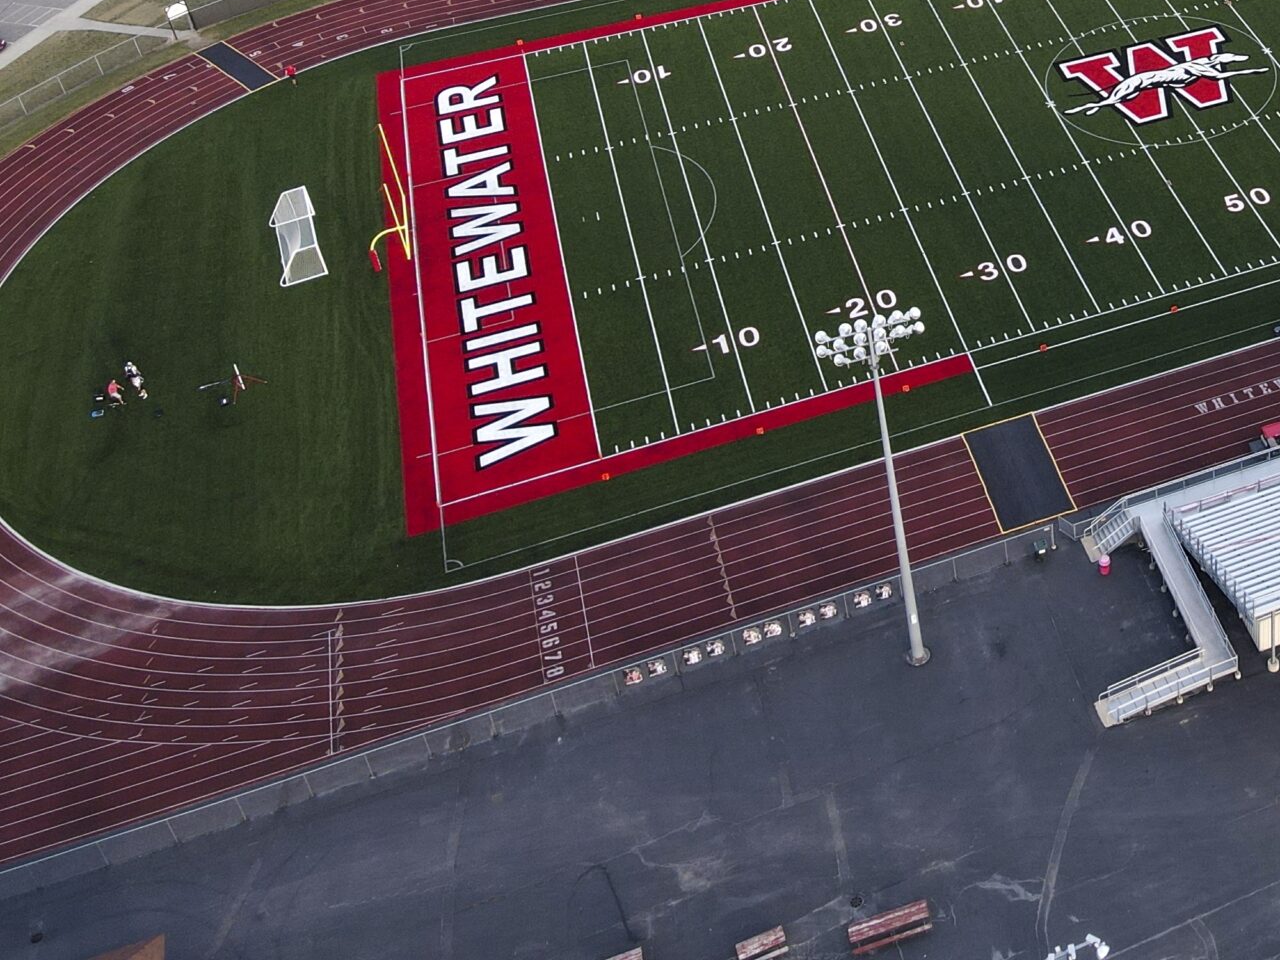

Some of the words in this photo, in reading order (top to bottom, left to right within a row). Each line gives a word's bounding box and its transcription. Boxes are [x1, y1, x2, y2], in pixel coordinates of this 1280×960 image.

[860, 12, 903, 33] 30
[748, 37, 793, 59] 20
[632, 64, 672, 85] 10
[1055, 24, 1234, 125] W
[1223, 186, 1272, 213] 50
[1104, 219, 1152, 246] 40
[436, 74, 558, 471] WHITEWATER
[977, 253, 1028, 282] 30
[845, 289, 898, 320] 20
[711, 326, 761, 355] 10
[533, 568, 550, 577] 1
[534, 580, 551, 591] 2
[536, 594, 554, 605] 3
[538, 610, 556, 620] 4
[540, 622, 558, 634] 5
[542, 637, 560, 648] 6
[544, 650, 562, 661] 7
[546, 666, 564, 678] 8
